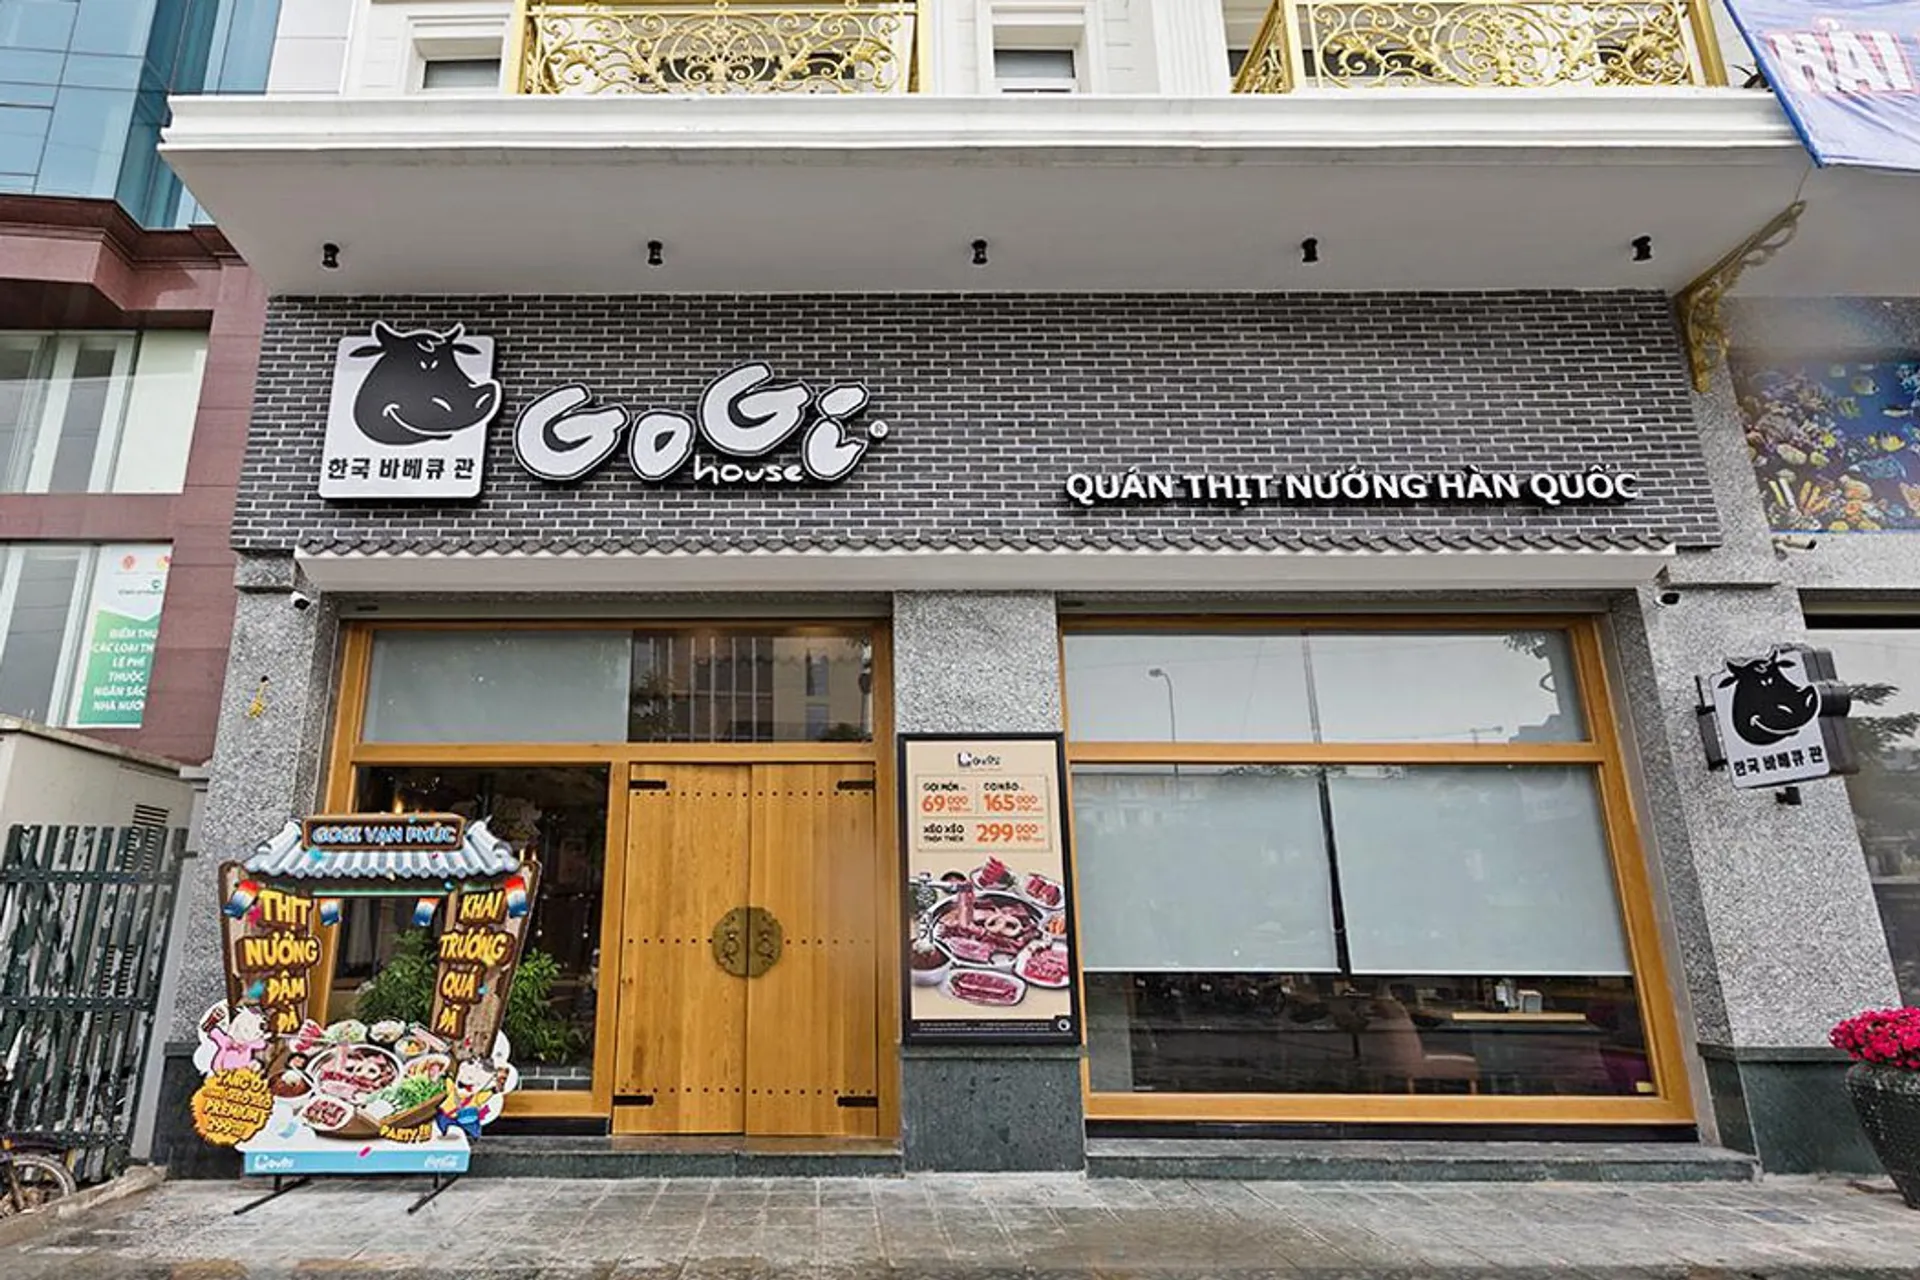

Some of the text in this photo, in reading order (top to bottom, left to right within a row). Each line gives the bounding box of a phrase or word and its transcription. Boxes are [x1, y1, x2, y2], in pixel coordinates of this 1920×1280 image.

[328, 458, 475, 480] 한국 바베큐 관
[693, 456, 804, 485] house
[1066, 465, 1640, 507] QUÁN THỊT NƯỚNG HÀN QUỐC
[922, 794, 945, 812] 69
[983, 794, 1015, 812] 165
[976, 823, 1013, 843] 299
[259, 889, 312, 930] THỊT
[460, 890, 503, 920] KHAI
[244, 931, 318, 966] NƯỚNG
[442, 965, 479, 999] QUÁ
